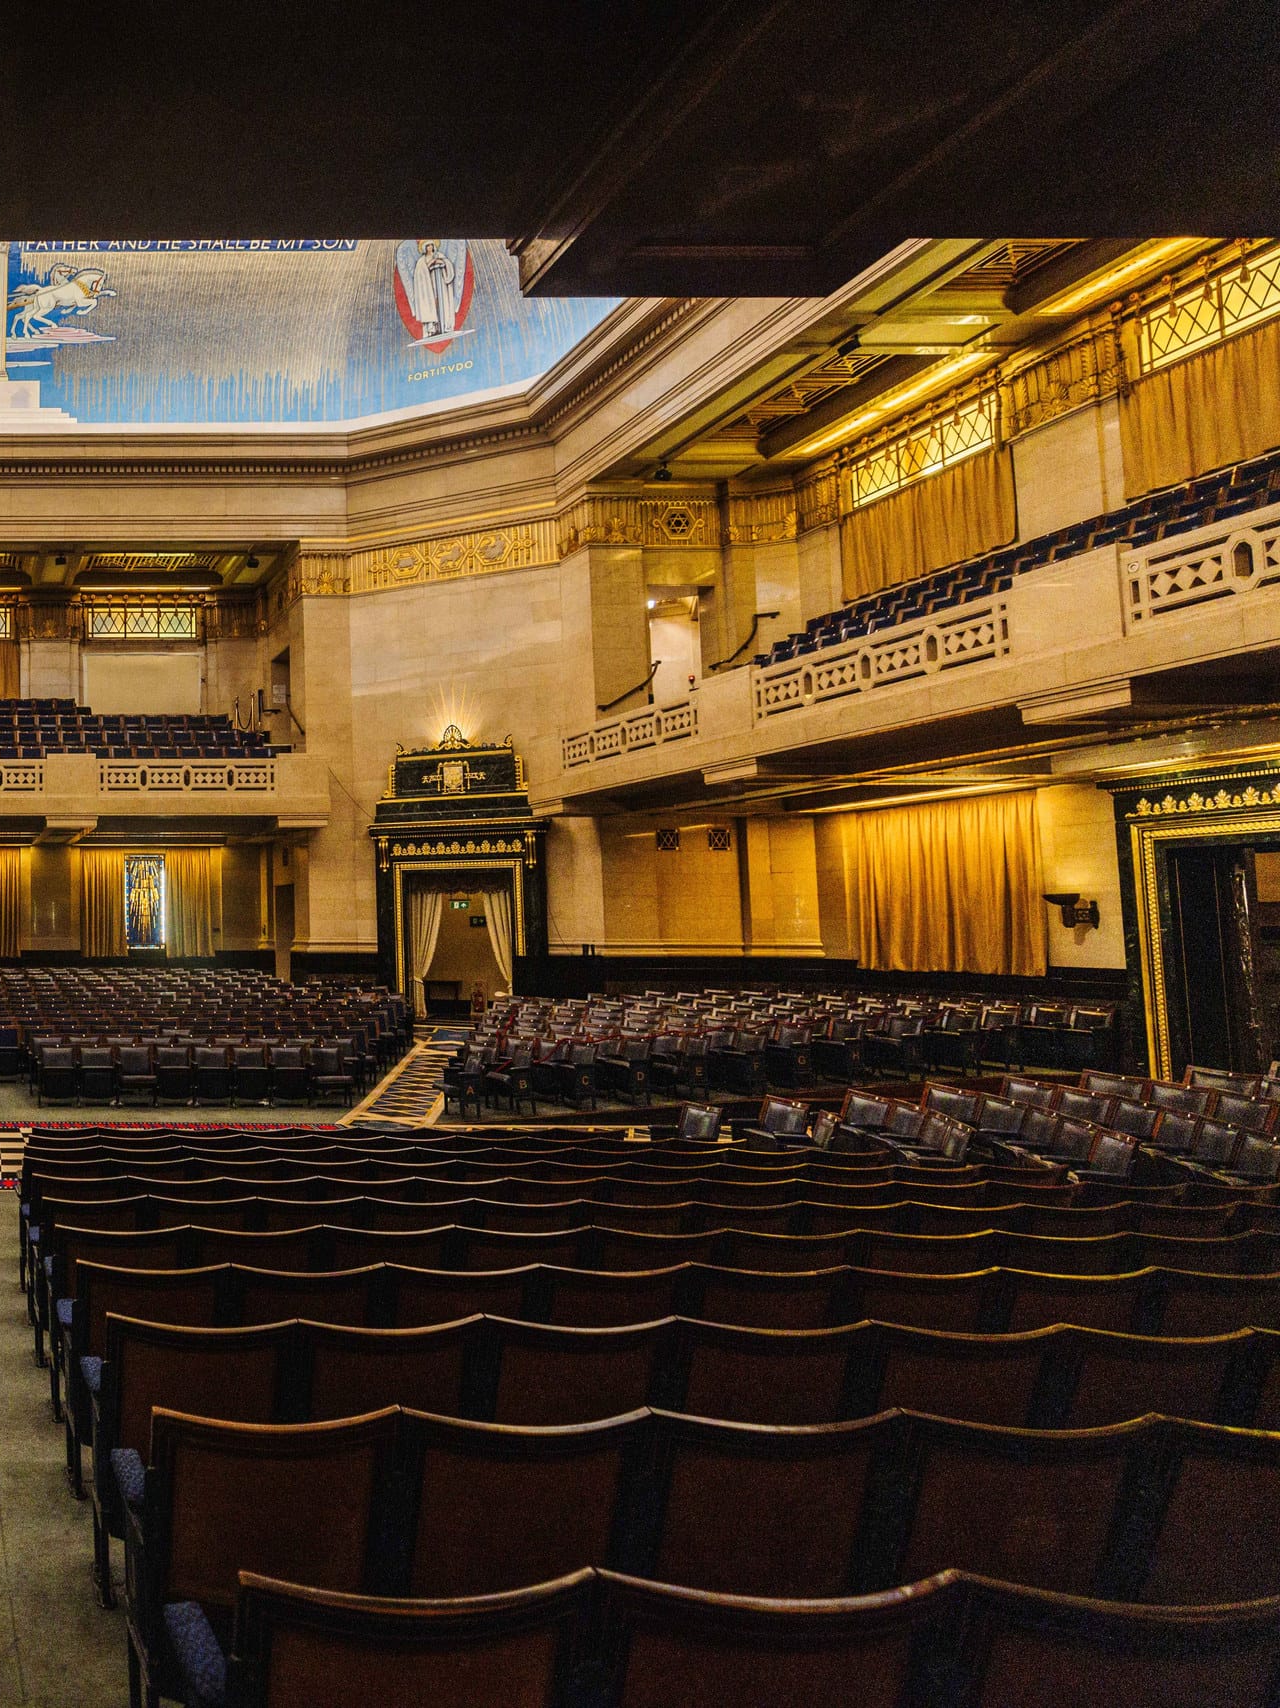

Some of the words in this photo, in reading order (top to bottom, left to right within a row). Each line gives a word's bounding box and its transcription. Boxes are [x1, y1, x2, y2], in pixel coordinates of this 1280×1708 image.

[26, 240, 100, 250] FATHER
[108, 240, 151, 250] AND
[157, 240, 181, 250] HE
[188, 239, 246, 250] SHALL
[249, 239, 271, 250] BE
[277, 239, 305, 249] MY
[312, 239, 356, 249] SON
[797, 1055, 807, 1065] G
[637, 1071, 645, 1081] D
[695, 1066, 703, 1076] E
[519, 1079, 528, 1089] B
[581, 1075, 590, 1086] C
